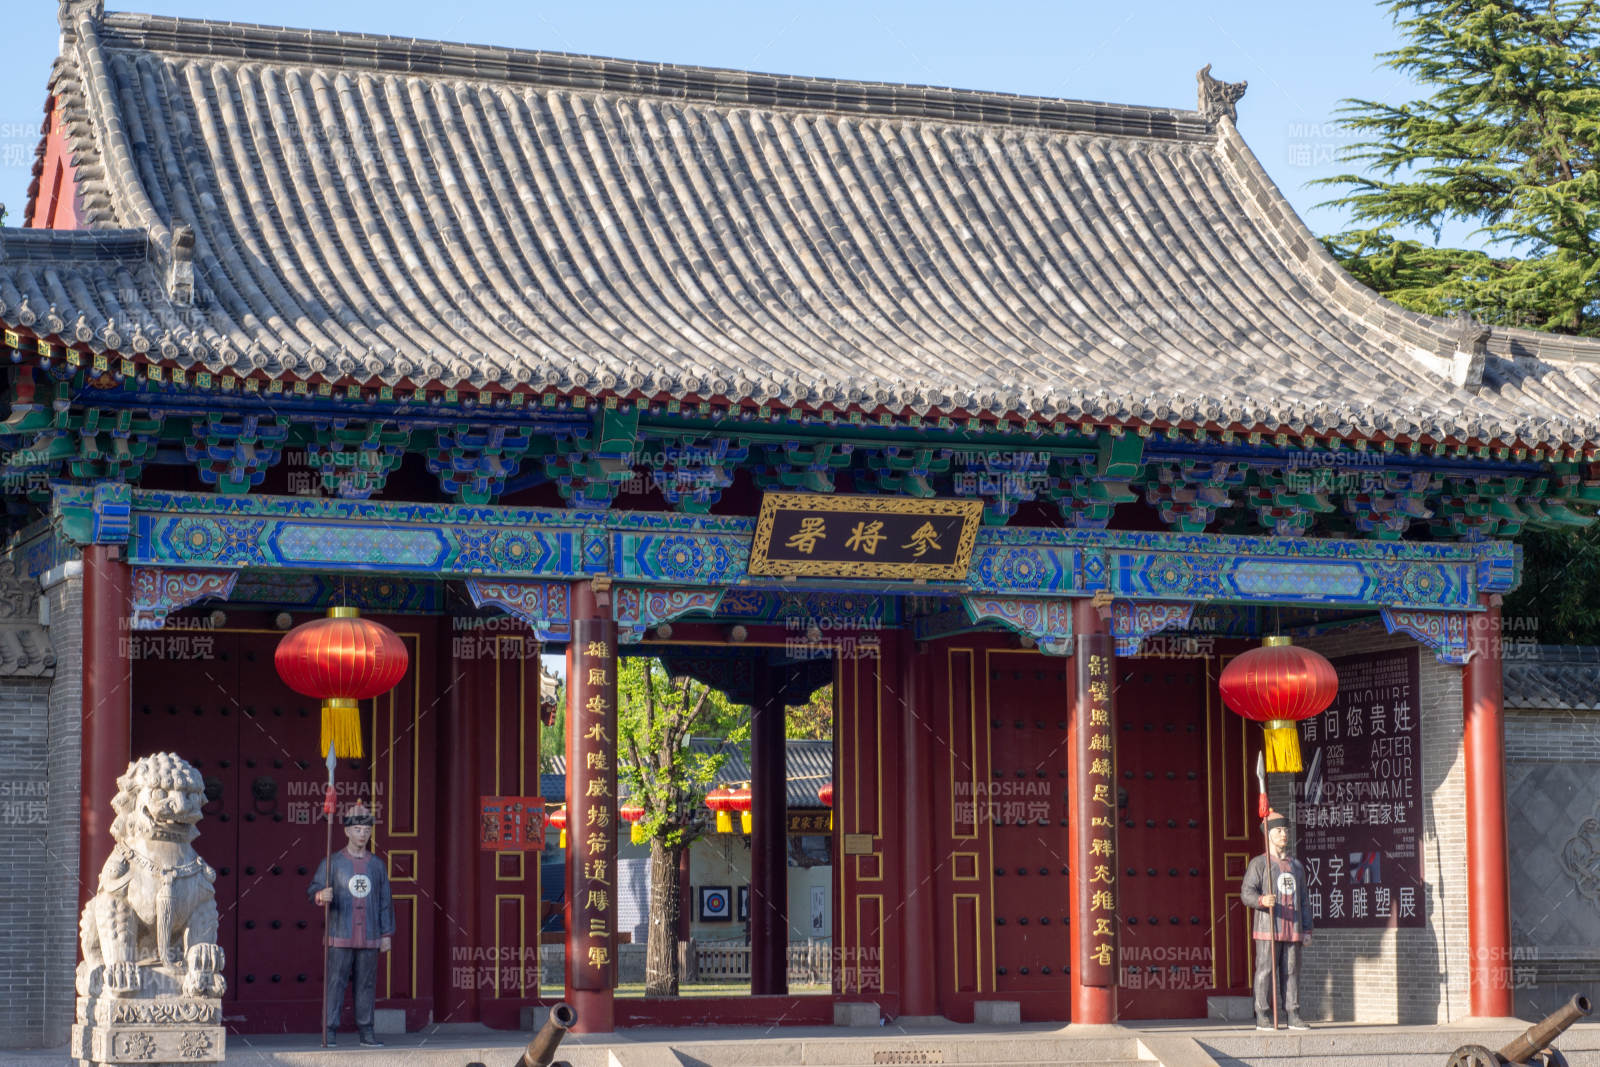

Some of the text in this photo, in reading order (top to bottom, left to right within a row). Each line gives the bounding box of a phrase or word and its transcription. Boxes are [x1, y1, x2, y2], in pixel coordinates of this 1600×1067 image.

[1302, 700, 1412, 742] 请问您贵姓
[1326, 744, 1344, 759] 2025
[1371, 736, 1412, 758] AFTER
[1371, 757, 1412, 779] YOUR
[1327, 778, 1413, 804] LAST NAME
[1306, 854, 1345, 887] 汉字
[354, 879, 367, 893] 兵
[1308, 886, 1416, 919] 抽象雕塑展
